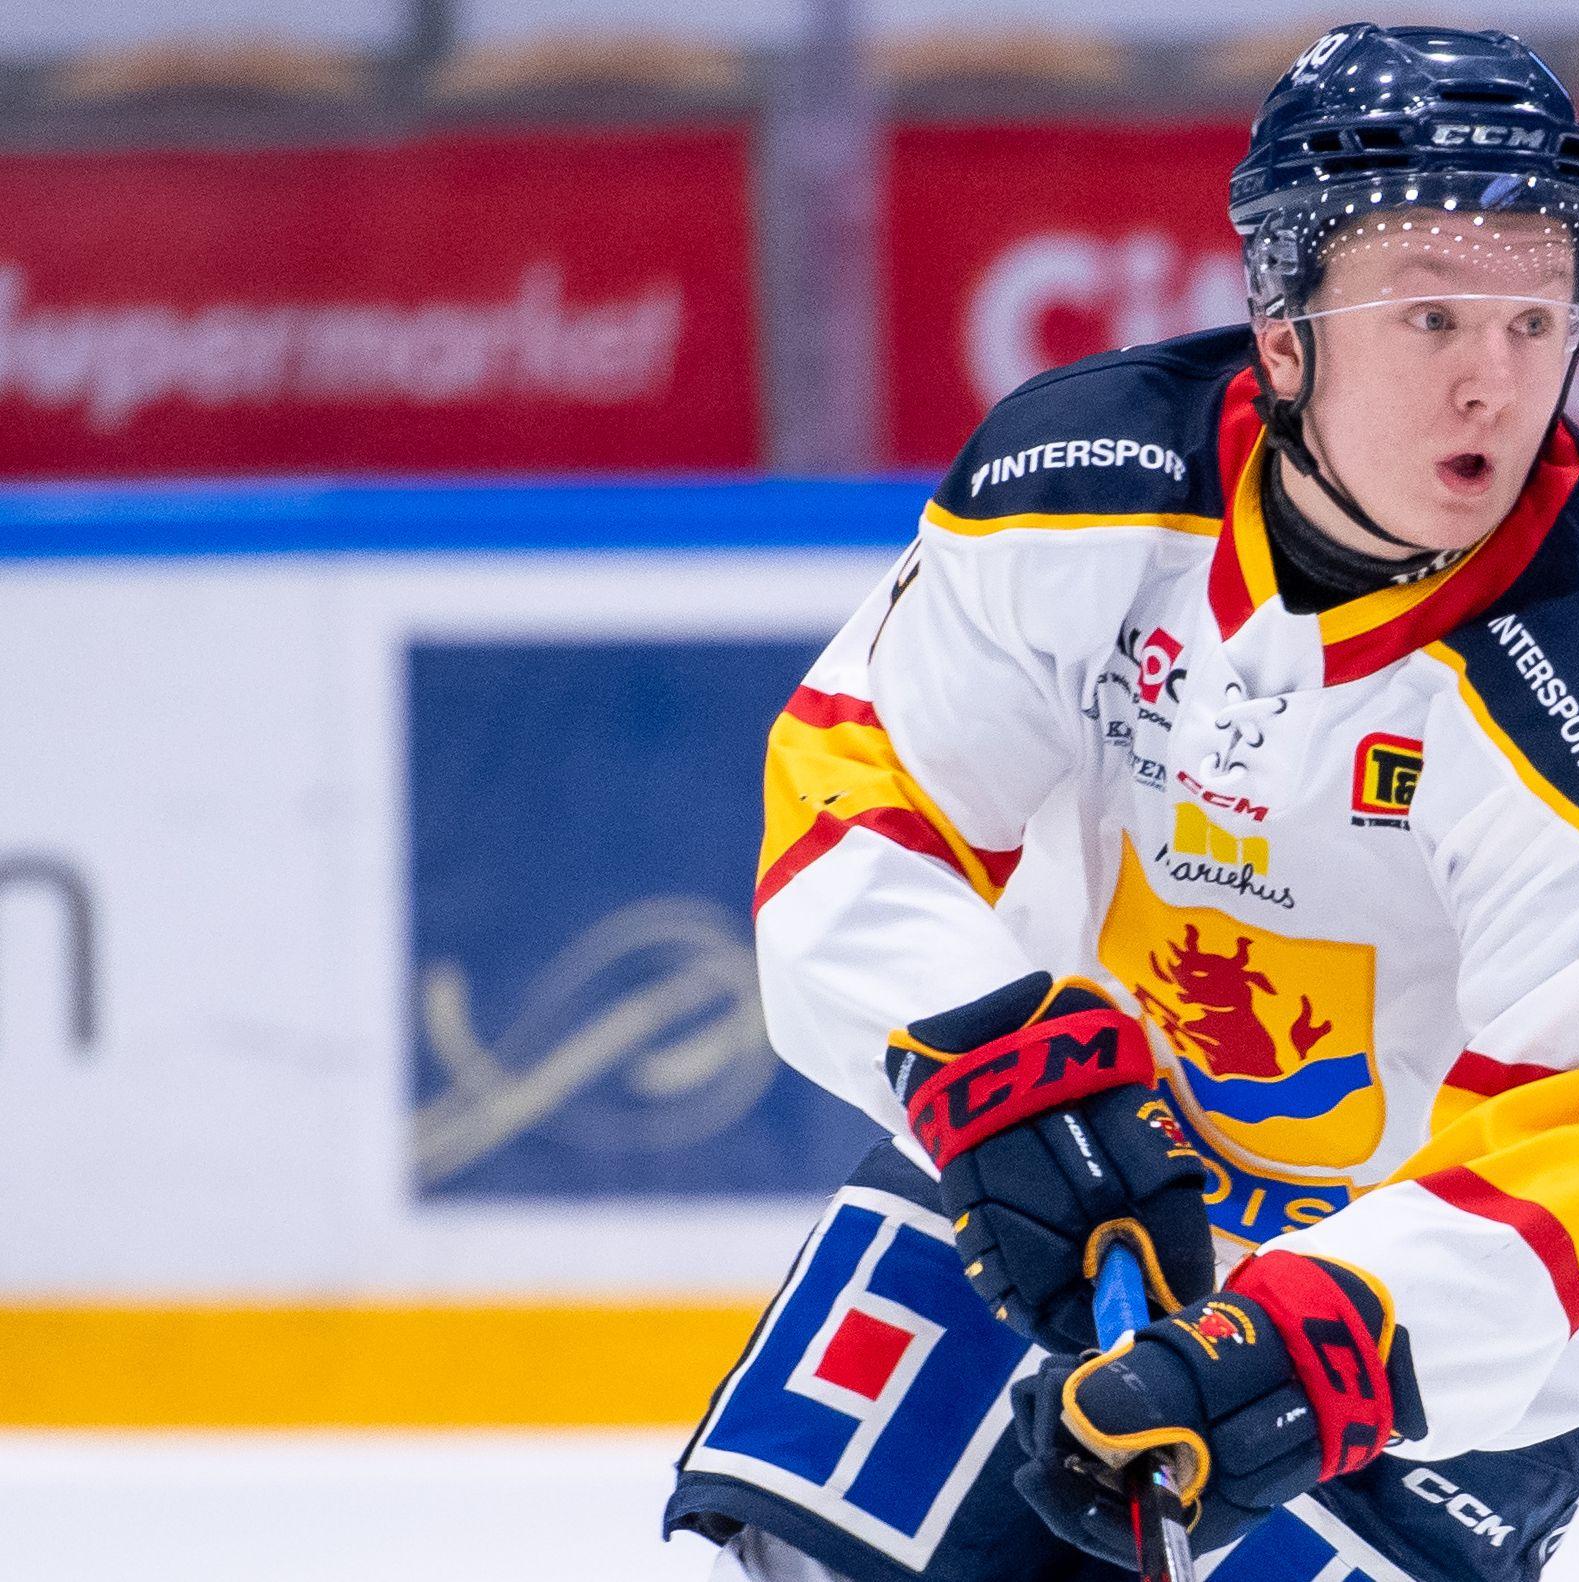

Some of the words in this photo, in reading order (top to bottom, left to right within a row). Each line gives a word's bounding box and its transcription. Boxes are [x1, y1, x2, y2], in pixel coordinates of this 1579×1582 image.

[1431, 124, 1546, 149] CCM
[0, 255, 687, 436] upermarket
[1155, 843, 1296, 910] ariehus
[1401, 1467, 1517, 1548] CCM
